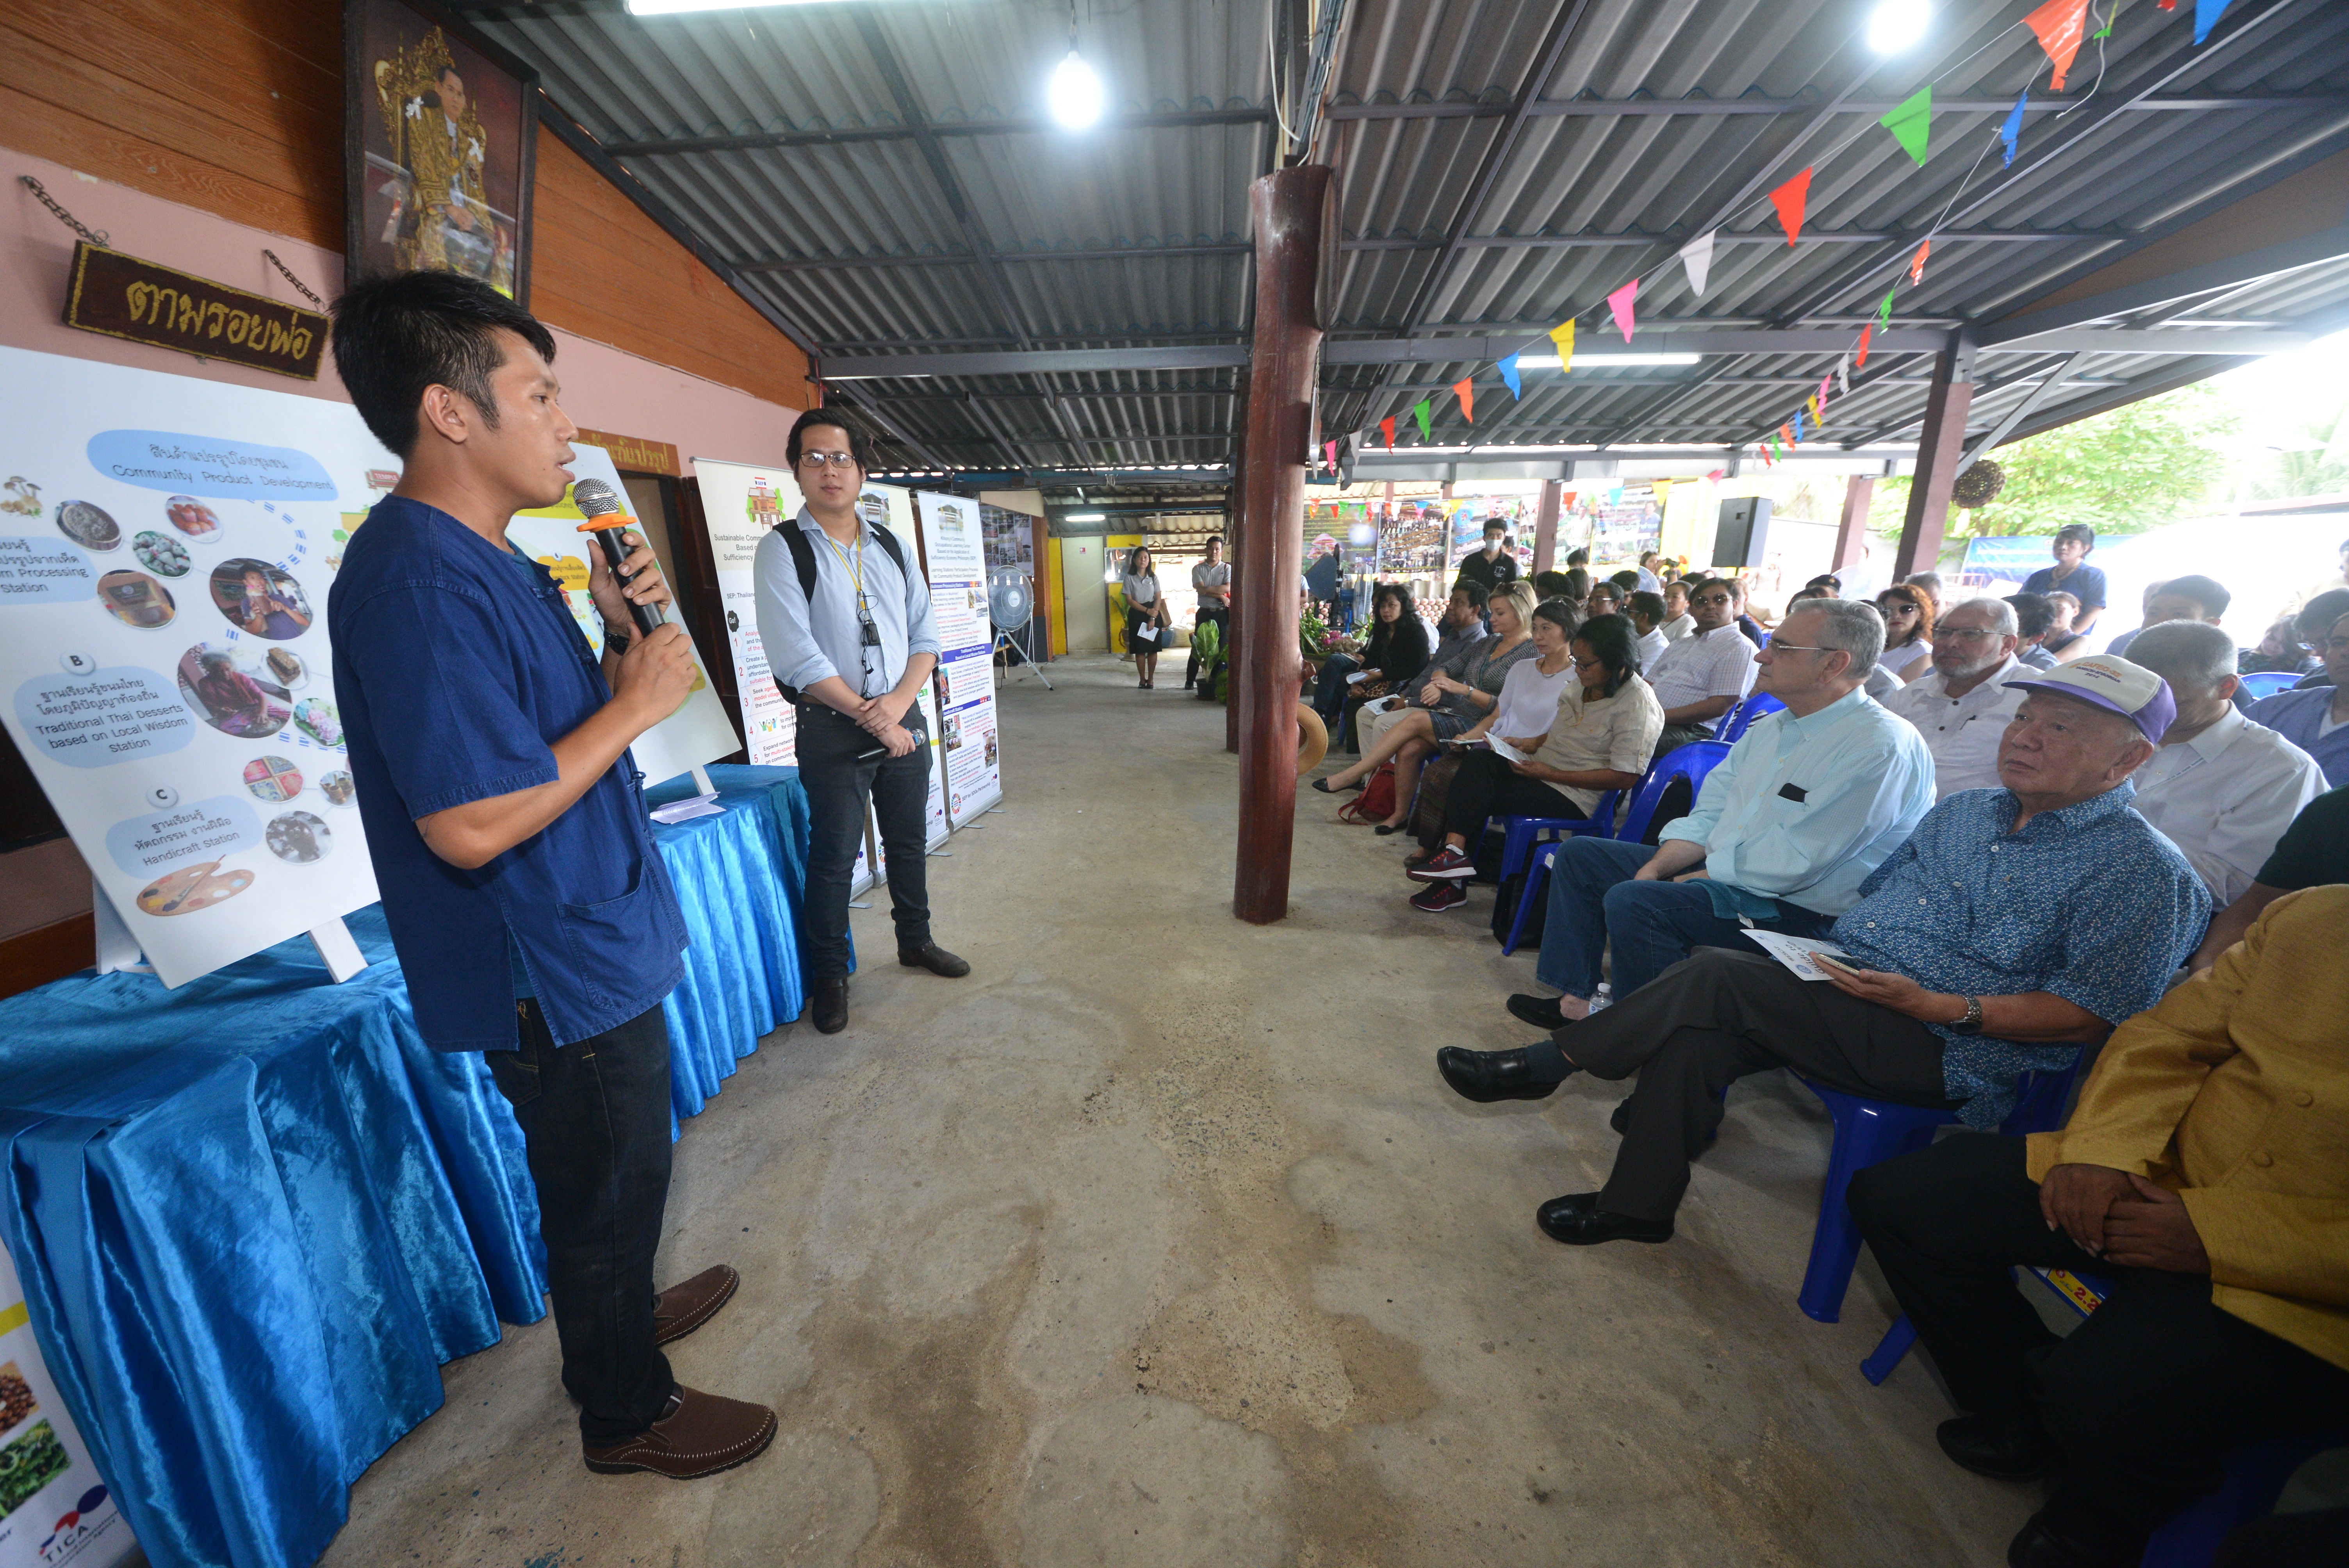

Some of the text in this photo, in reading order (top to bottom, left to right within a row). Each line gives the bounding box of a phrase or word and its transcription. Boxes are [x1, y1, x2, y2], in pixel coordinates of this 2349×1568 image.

[126, 280, 313, 361] ตามรอยพ่อ
[112, 465, 333, 490] Community Product Development
[1455, 533, 1475, 544] Siam
[18, 567, 89, 577] Processing
[0, 583, 48, 593] Station
[734, 638, 738, 647] 1
[70, 656, 83, 666] B
[739, 667, 743, 676] 2
[41, 678, 144, 702] ฐานเรียนรู้ขนมไทย
[744, 698, 748, 706] 3
[763, 698, 784, 706] community
[36, 704, 184, 735] Traditional Thai Desserts
[48, 717, 188, 749] based on Local Wisdom
[750, 726, 753, 734] 4
[109, 738, 151, 753] Station
[763, 742, 779, 751] Expand
[754, 754, 758, 763] 5
[772, 753, 791, 763] community
[978, 782, 991, 792] Partnership
[156, 789, 168, 799] C
[151, 809, 205, 833] ฐานเรียนรู้
[135, 818, 232, 851] หัตถกรรม งานฝีมือ
[143, 832, 240, 866] Handicraft Station
[43, 1525, 88, 1562] TICA
